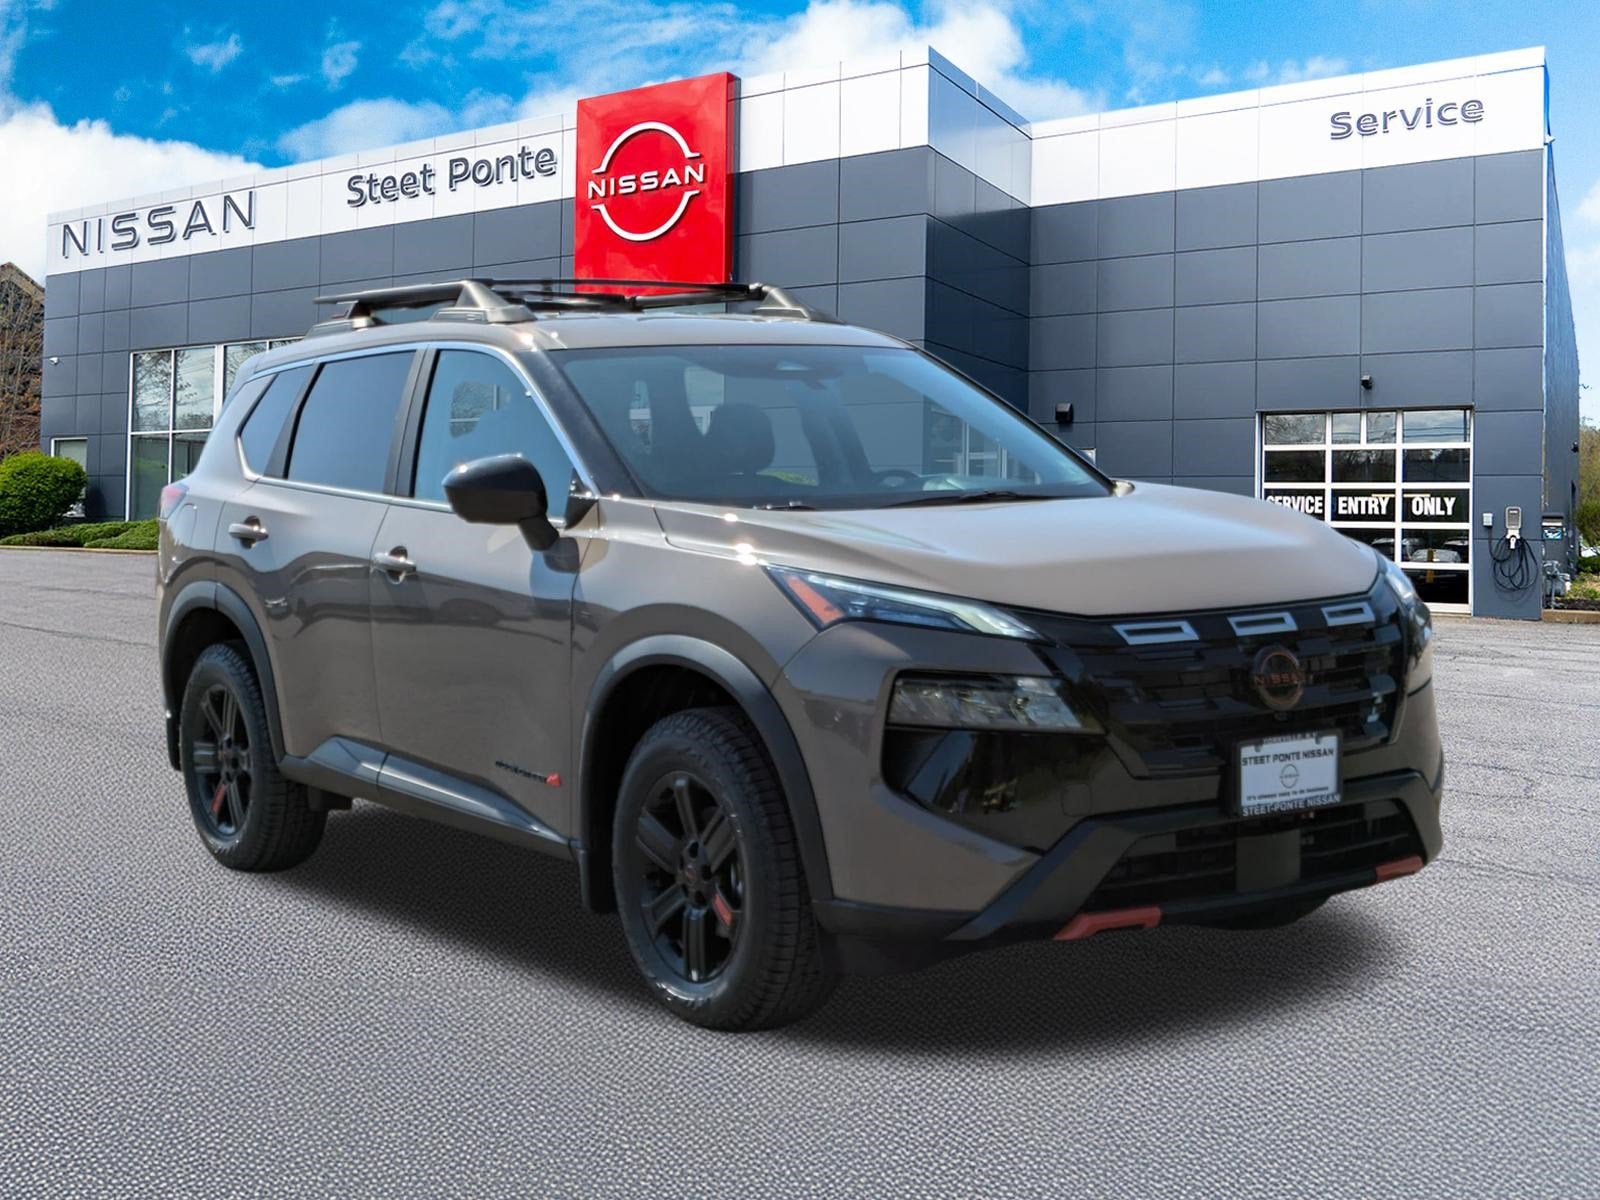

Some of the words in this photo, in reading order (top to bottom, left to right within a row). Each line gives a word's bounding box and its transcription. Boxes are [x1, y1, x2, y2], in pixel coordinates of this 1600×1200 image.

[1330, 98, 1484, 140] Service
[347, 163, 436, 207] Steet
[449, 145, 557, 191] Ponte
[587, 163, 705, 200] NISSAN
[62, 190, 256, 259] NISSAN
[1338, 496, 1389, 515] ENTRY
[1412, 497, 1456, 515] ONLY
[1241, 754, 1271, 767] STEET
[1272, 751, 1300, 763] PONTE
[1302, 748, 1334, 760] NISSAN
